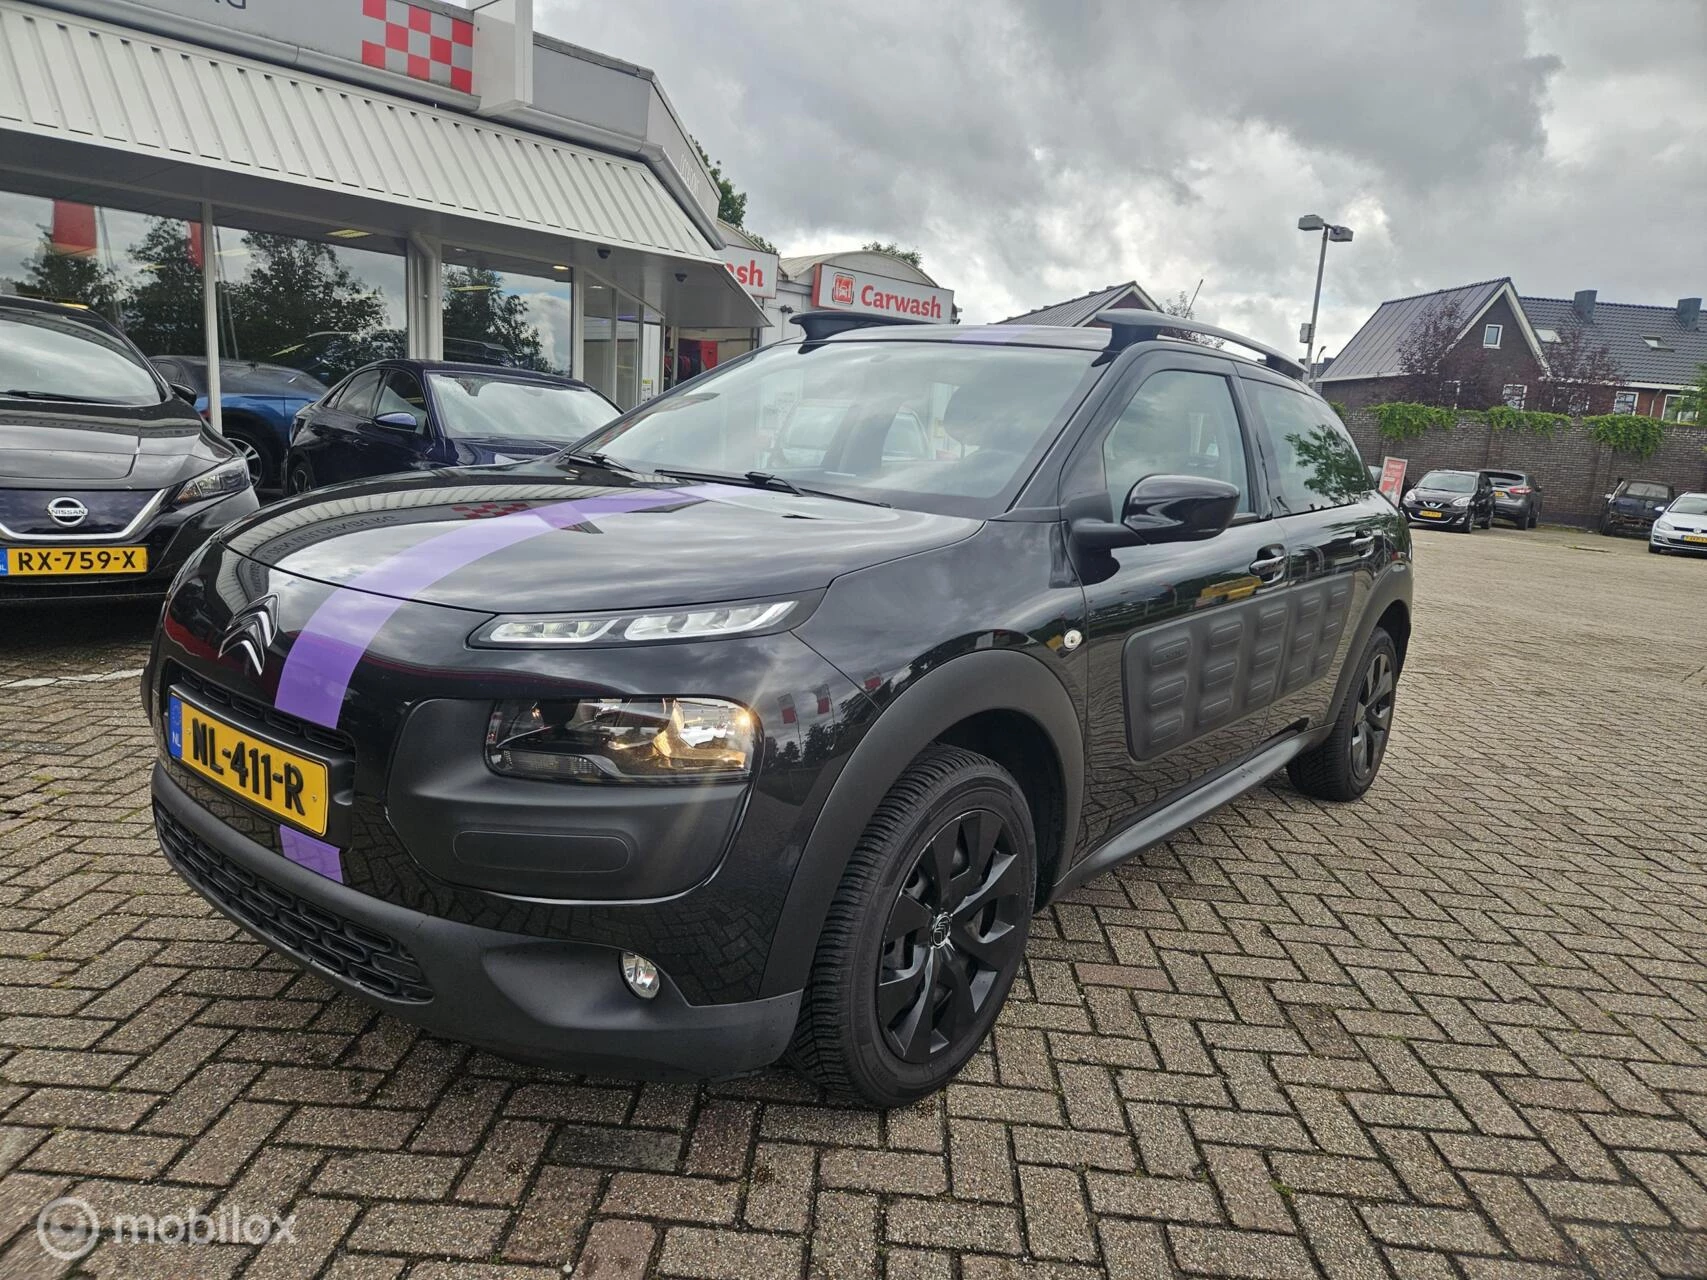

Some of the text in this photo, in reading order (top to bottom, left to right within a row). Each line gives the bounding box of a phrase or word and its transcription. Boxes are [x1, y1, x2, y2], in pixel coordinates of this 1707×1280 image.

[860, 284, 942, 319] Carwash
[18, 550, 137, 571] RX-759-X
[172, 731, 182, 748] NL
[192, 717, 306, 816] NL-411-R
